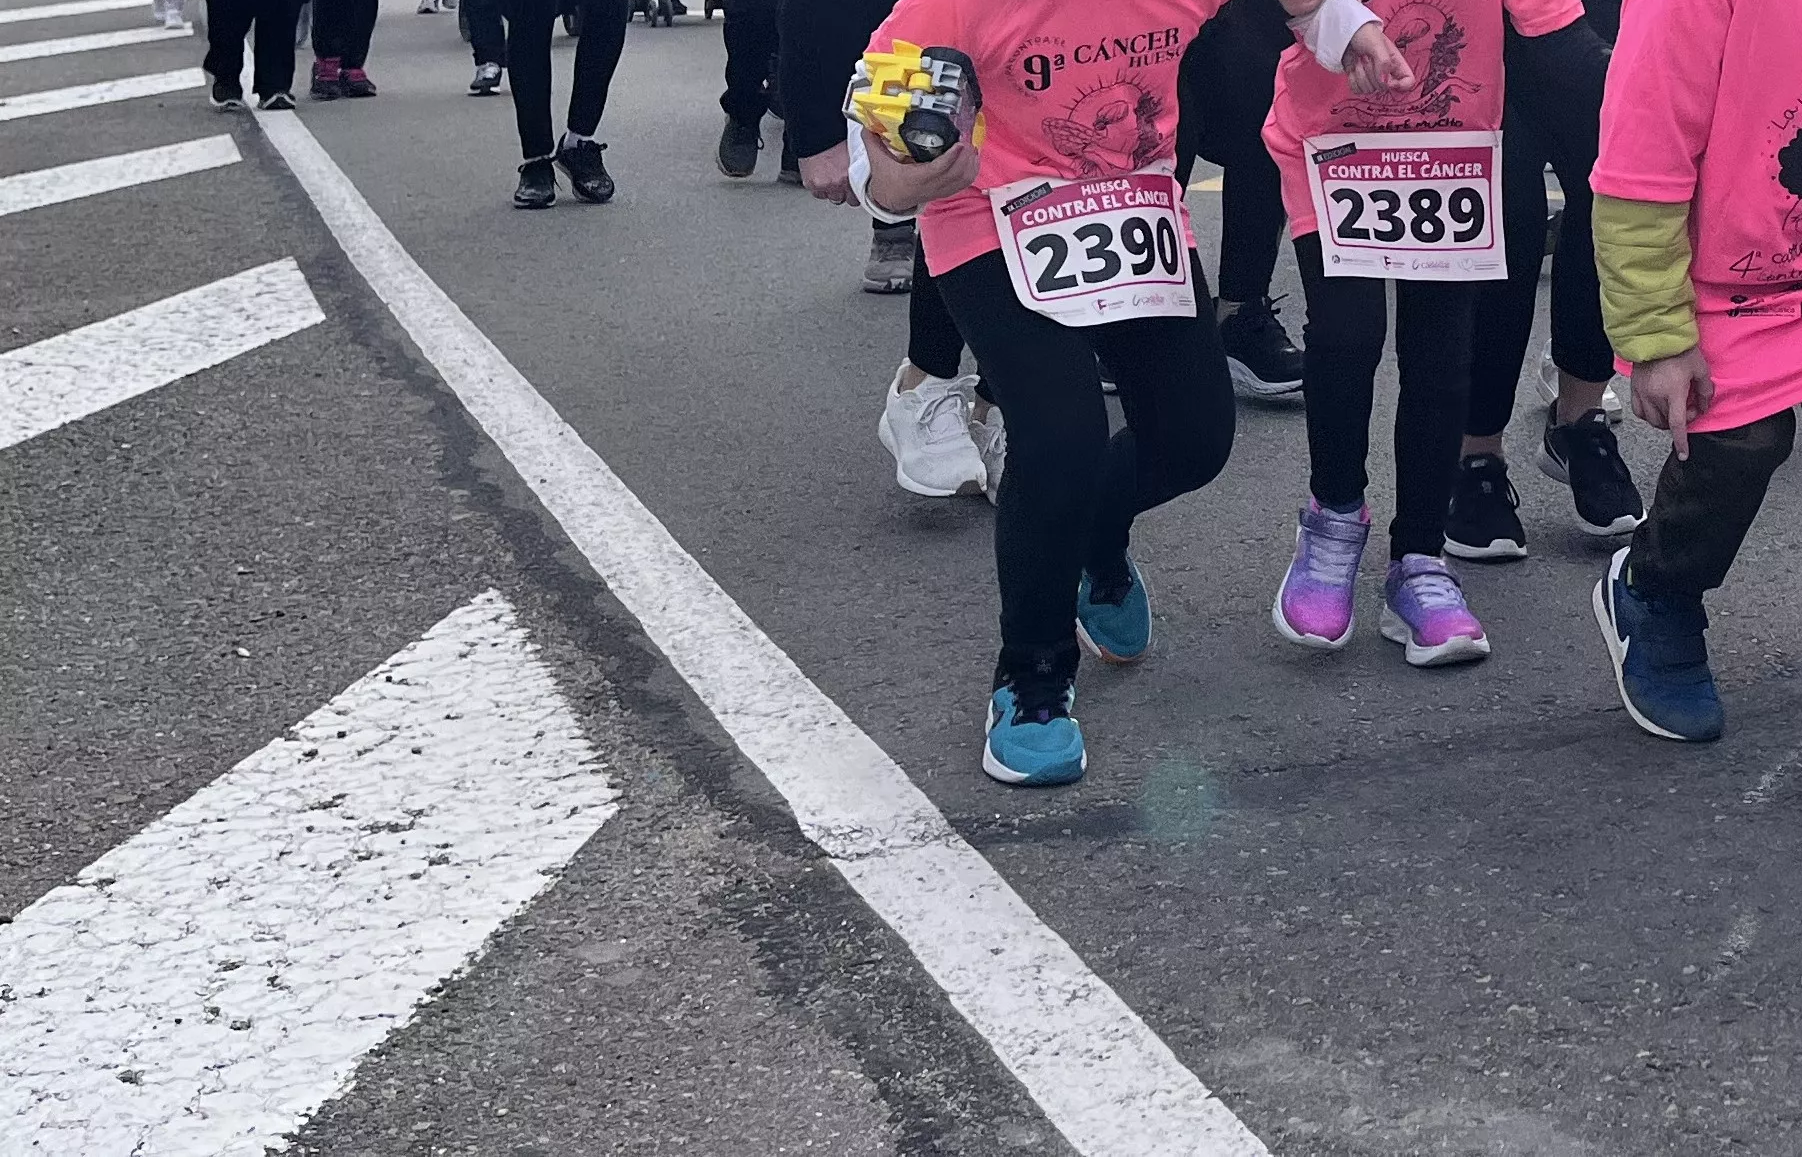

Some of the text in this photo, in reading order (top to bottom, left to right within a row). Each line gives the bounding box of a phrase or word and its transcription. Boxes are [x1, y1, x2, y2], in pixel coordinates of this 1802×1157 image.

[1023, 54, 1065, 91] 9ª
[1074, 27, 1180, 64] CÁNCER
[1327, 161, 1483, 179] CONTRA EL CÁNCER
[1381, 151, 1430, 163] HUESCA
[1021, 187, 1171, 226] CONTRA EL CÁNCER
[1080, 178, 1132, 197] HUESCA
[1329, 186, 1485, 244] 2389
[1024, 215, 1179, 294] 2390
